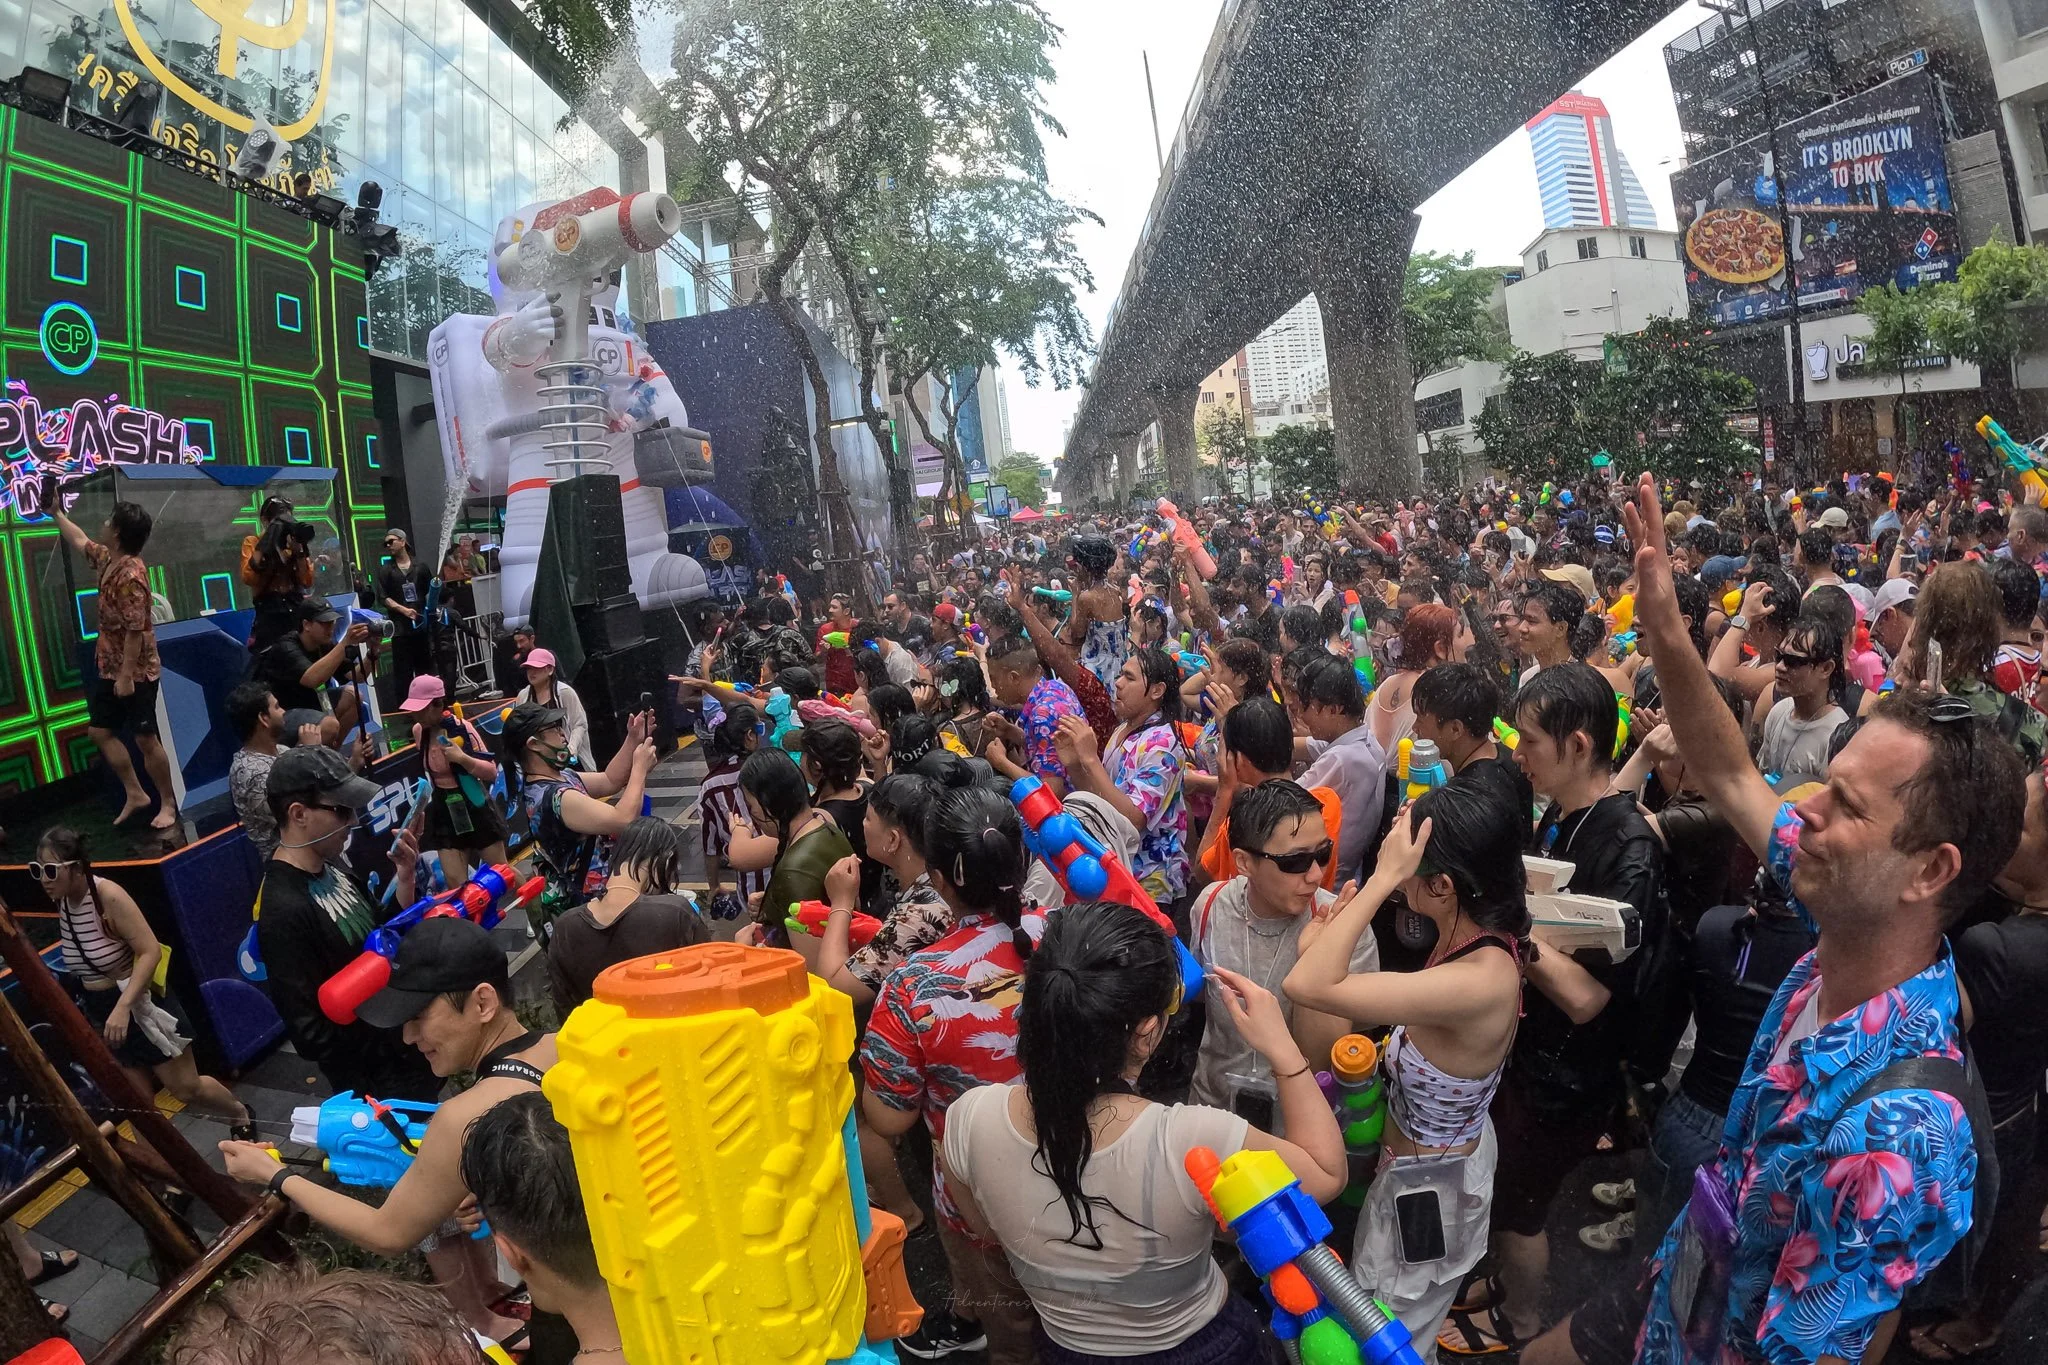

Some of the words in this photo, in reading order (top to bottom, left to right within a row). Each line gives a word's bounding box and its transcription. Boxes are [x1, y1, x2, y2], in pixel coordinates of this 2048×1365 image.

[1890, 58, 1914, 74] Plan
[1558, 100, 1574, 108] SST
[1802, 144, 1828, 169] IT'S
[1832, 126, 1913, 163] BROOKLYN
[1829, 166, 1849, 189] TO
[1854, 159, 1886, 186] BKK
[556, 226, 577, 247] CP
[1910, 259, 1949, 273] Domino's
[49, 322, 90, 353] CP
[436, 344, 448, 360] CP
[597, 347, 618, 364] CP
[367, 777, 418, 833] SPL
